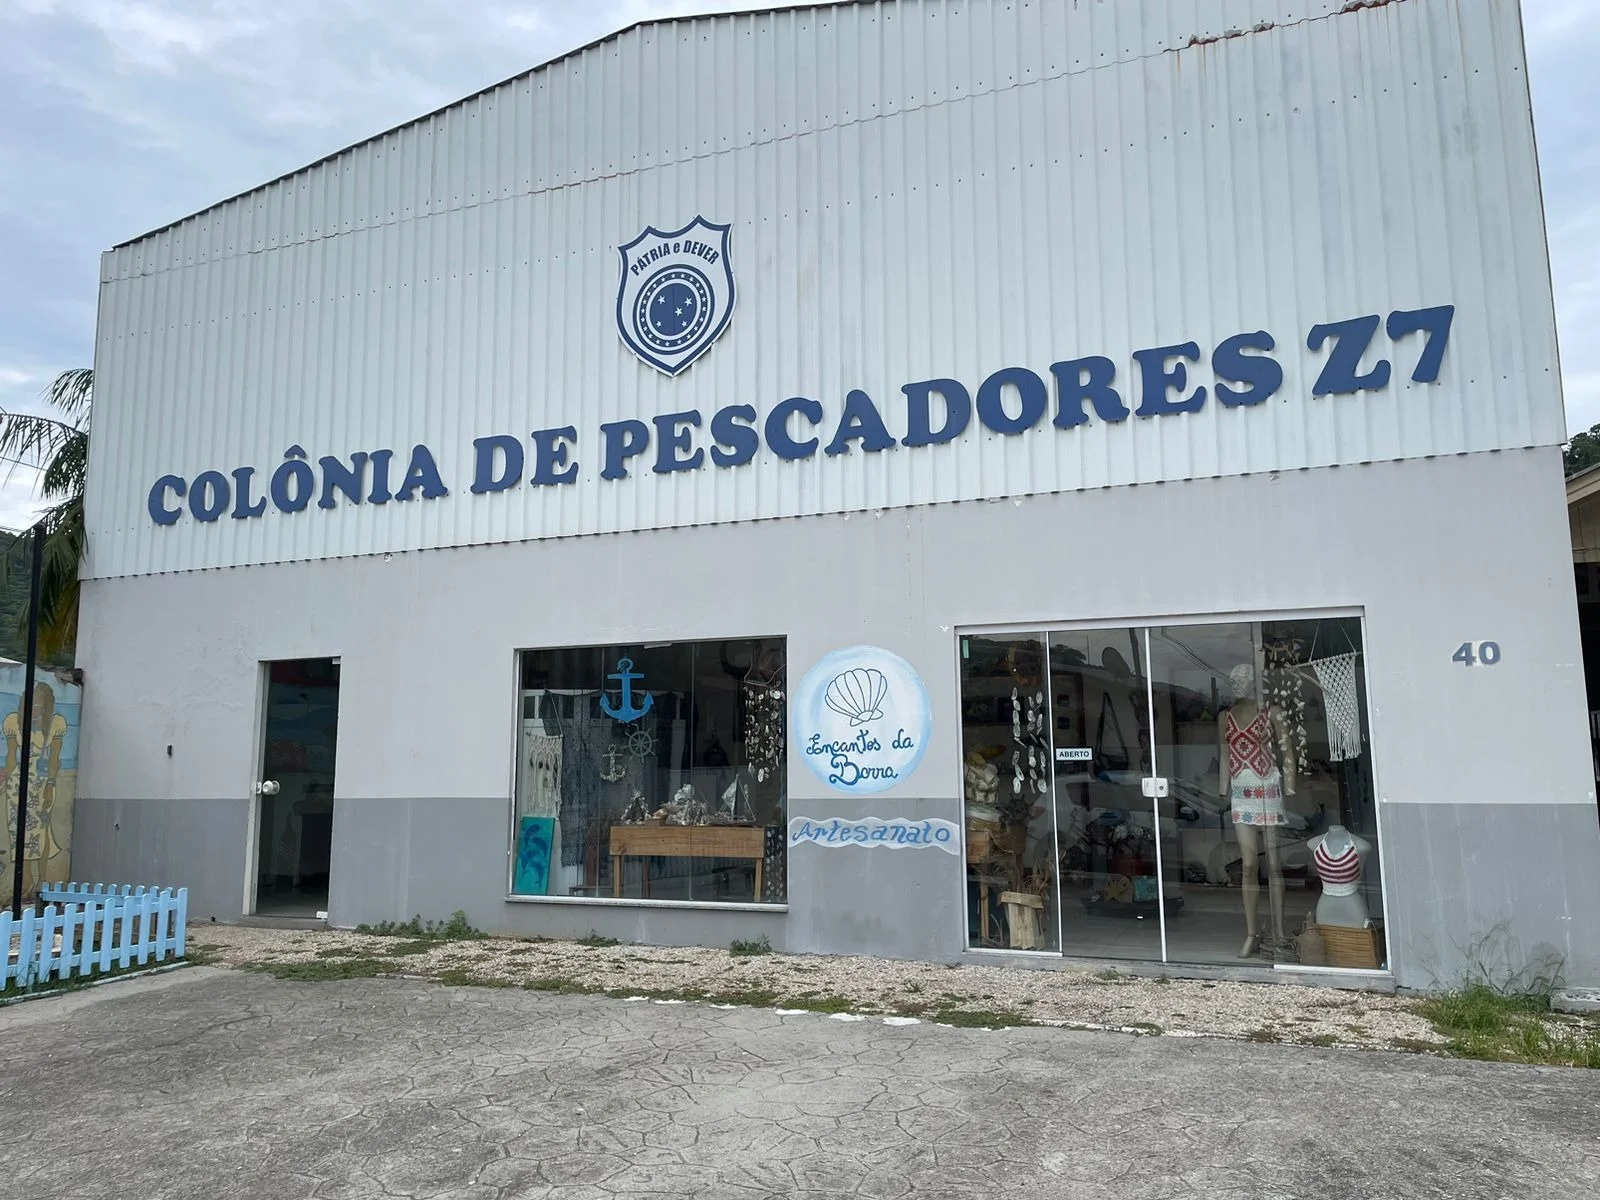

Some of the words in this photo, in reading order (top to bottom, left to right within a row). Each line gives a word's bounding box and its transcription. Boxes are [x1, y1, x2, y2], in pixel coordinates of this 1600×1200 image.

[630, 243, 671, 276] PÁTRIA
[673, 242, 681, 254] e
[683, 240, 720, 265] DEVER
[147, 444, 449, 525] COLÔNIA
[471, 425, 579, 493] DE
[600, 330, 1285, 481] PESCADORES
[1307, 304, 1456, 397] Z7
[1452, 641, 1501, 667] 40
[806, 729, 881, 755] Encantos
[892, 728, 914, 749] da
[1059, 750, 1090, 758] ABERTO
[792, 820, 951, 844] Artesanato
